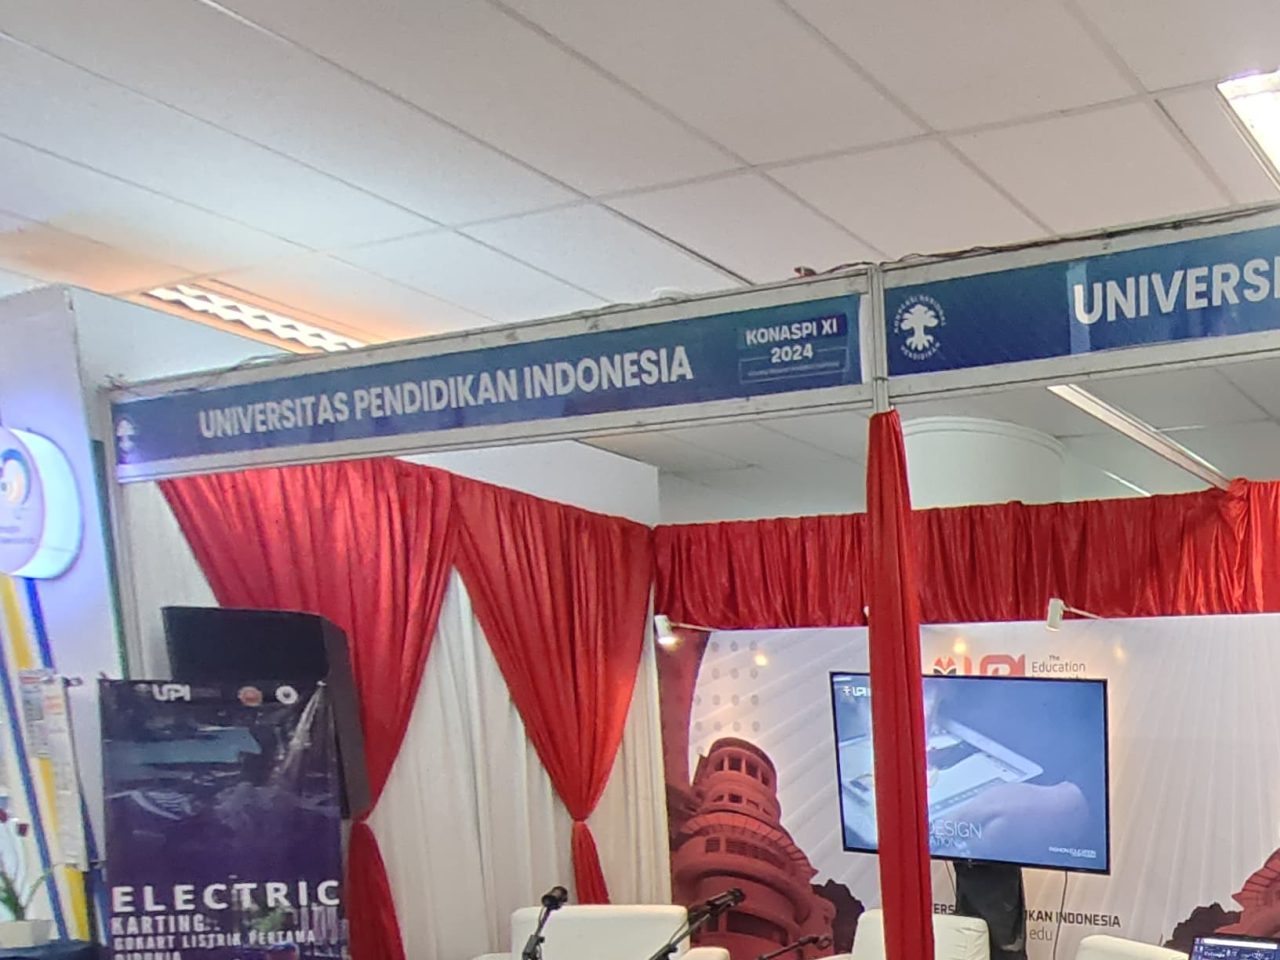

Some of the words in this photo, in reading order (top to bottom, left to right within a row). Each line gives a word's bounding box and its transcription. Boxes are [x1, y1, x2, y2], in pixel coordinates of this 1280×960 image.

[746, 321, 817, 345] KONASPI
[822, 318, 837, 335] XI
[771, 343, 813, 363] 2024
[200, 396, 350, 439] UNIVERSITAS
[354, 373, 517, 418] PENDIDIKAN
[525, 345, 693, 400] INDONESIA
[1032, 661, 1086, 673] Education
[152, 684, 190, 701] UPI
[112, 880, 340, 913] ELECTRIC
[111, 914, 205, 935] KARTING
[1056, 912, 1121, 928] INDONESIA
